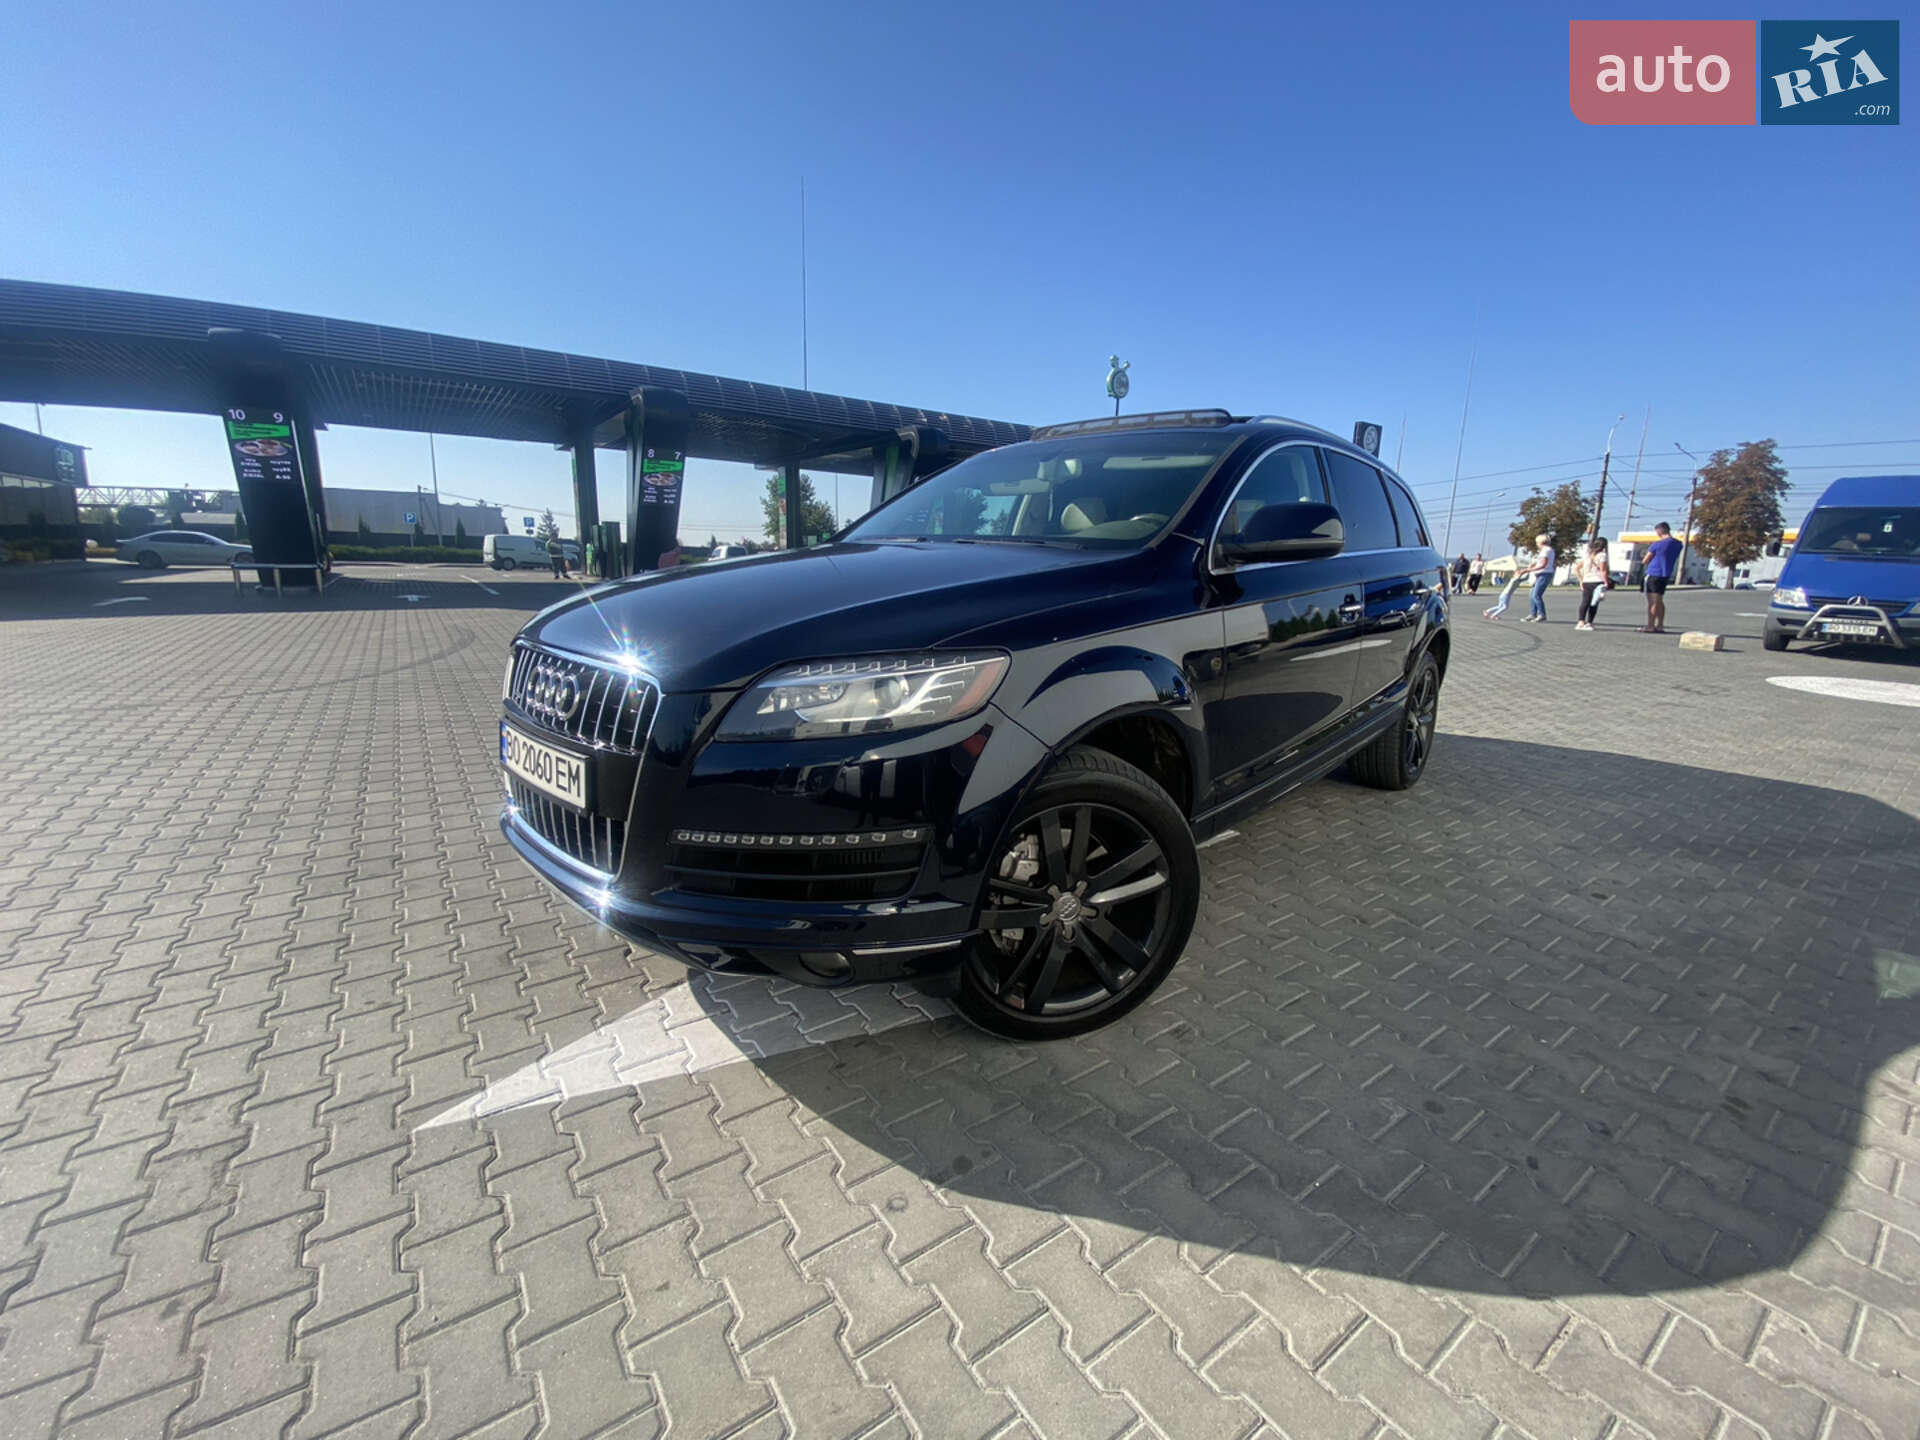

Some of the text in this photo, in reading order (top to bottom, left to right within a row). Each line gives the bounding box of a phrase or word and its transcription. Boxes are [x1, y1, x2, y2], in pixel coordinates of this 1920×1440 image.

[228, 408, 284, 423] 10 9
[647, 448, 681, 460] 8 7
[506, 730, 581, 798] BO 2060 EM
